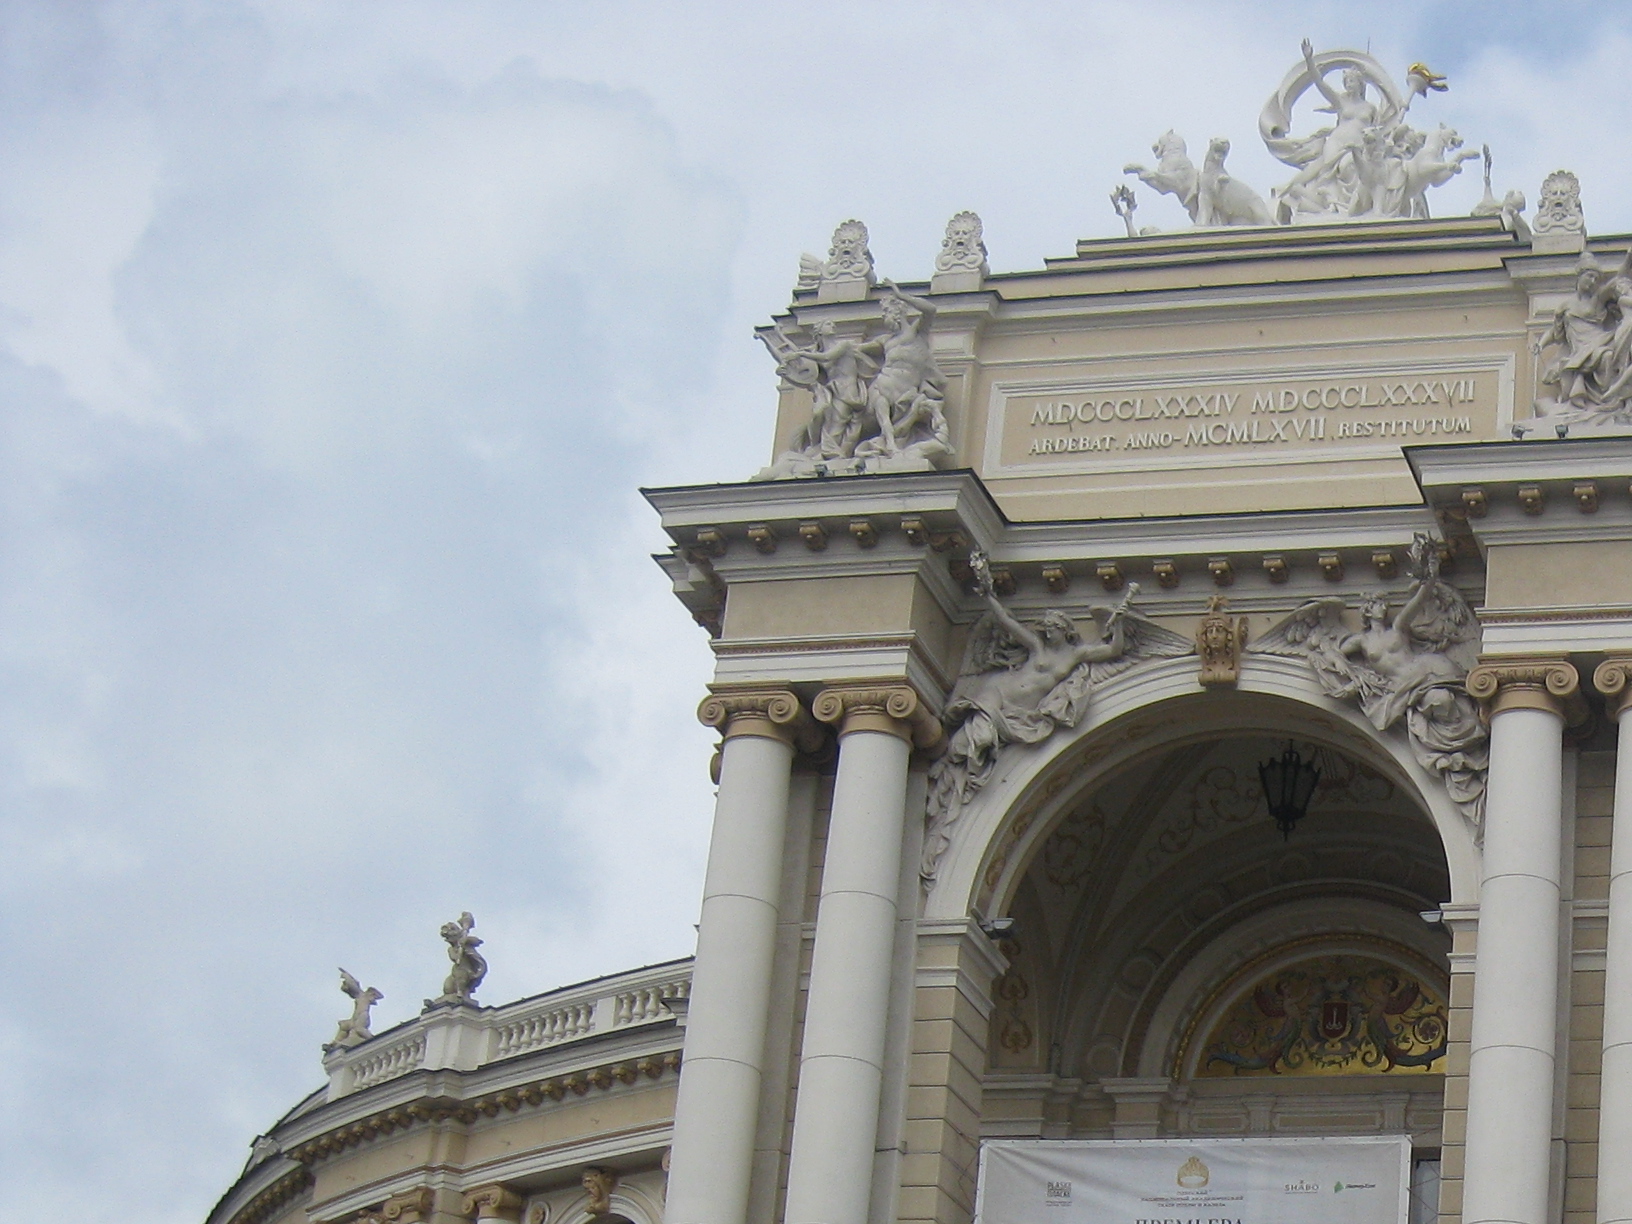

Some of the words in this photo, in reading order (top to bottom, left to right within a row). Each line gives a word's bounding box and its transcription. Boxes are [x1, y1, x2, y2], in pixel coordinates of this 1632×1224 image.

[1030, 392, 1240, 427] MDCCCLXXXIV
[1251, 379, 1475, 414] MDCCCLXXXVII
[1338, 416, 1471, 440] RESTITUTUM
